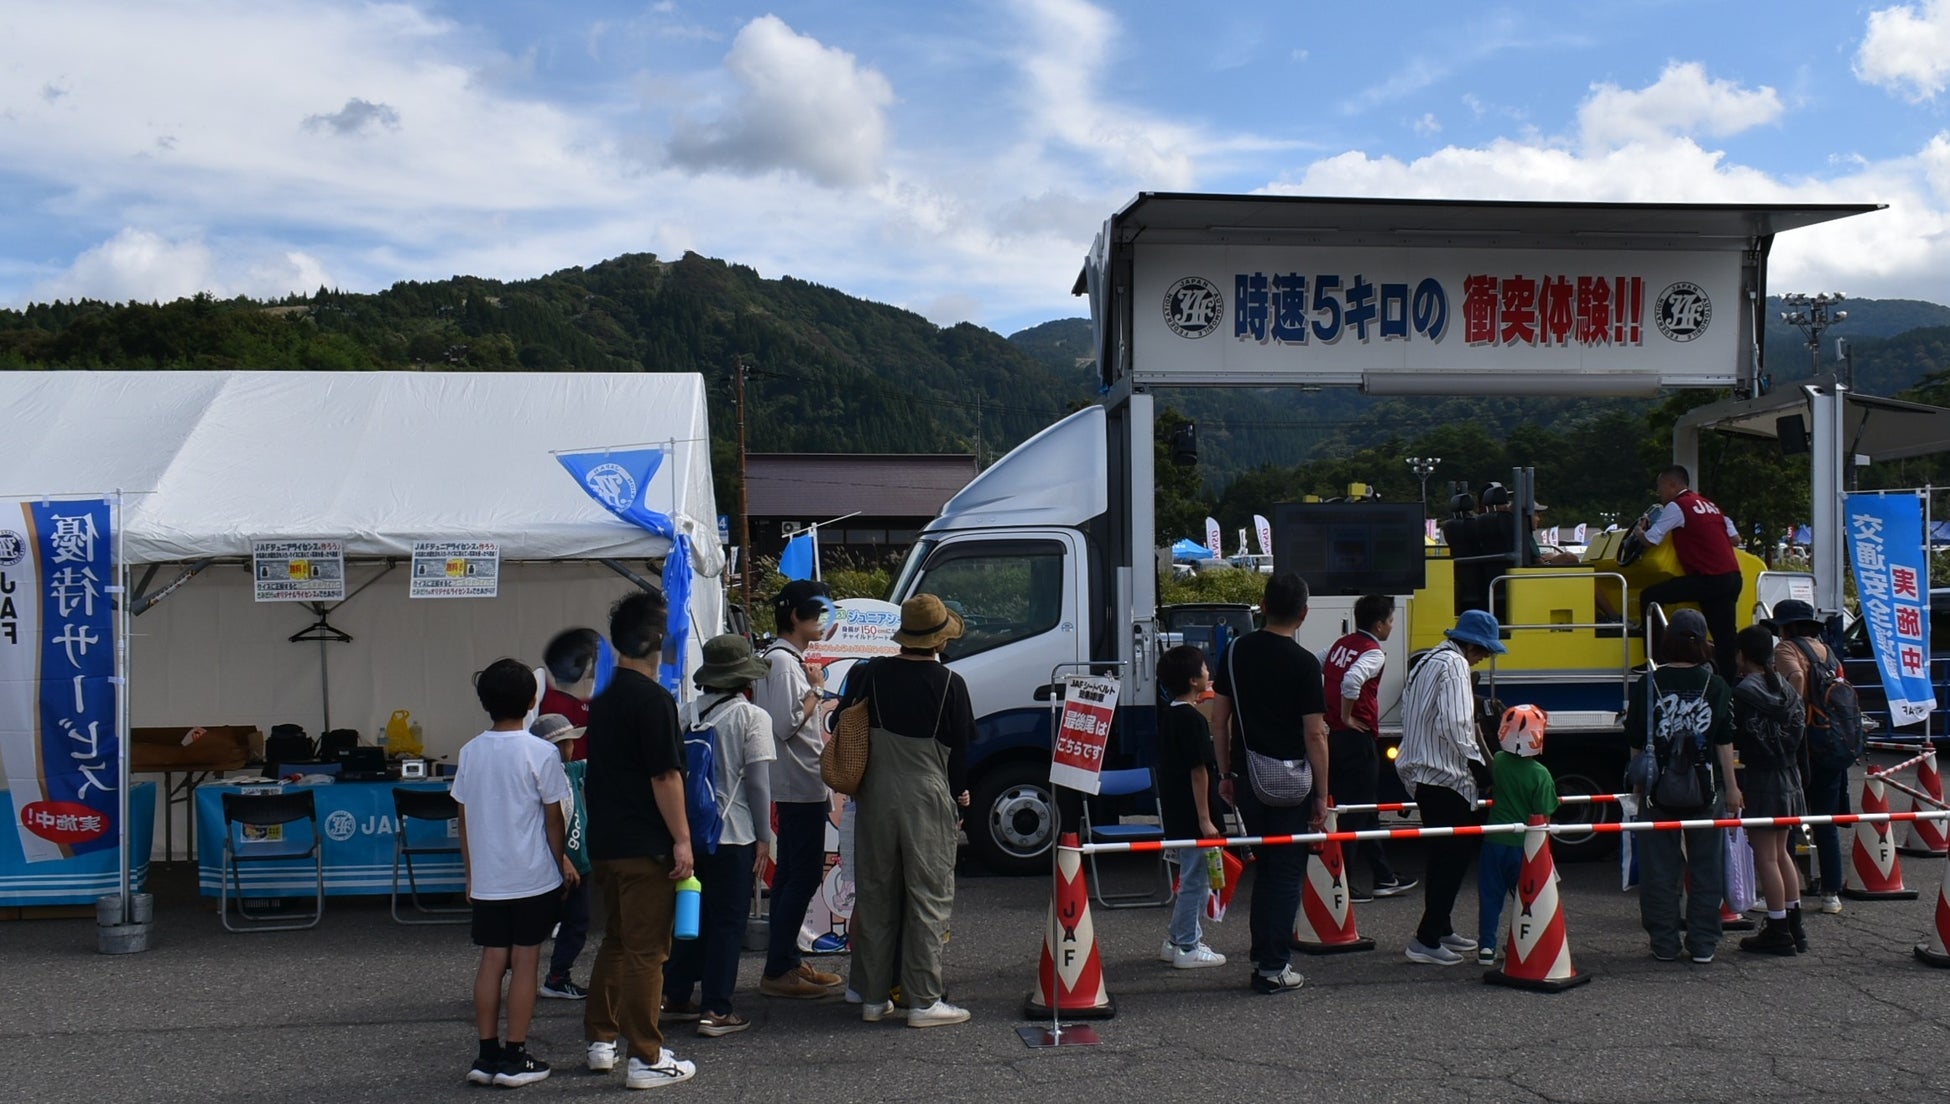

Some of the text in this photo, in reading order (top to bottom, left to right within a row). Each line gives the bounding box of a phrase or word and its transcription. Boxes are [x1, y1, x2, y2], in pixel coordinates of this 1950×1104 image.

[1164, 279, 1222, 337] JAPAN AUTOMOBILE FEDERATION
[1234, 272, 1645, 346] 時速5キロの 衝突体験!!
[1656, 283, 1710, 340] JAPAN AUTOMOBILE FEDERATION
[718, 517, 727, 529] 4
[1330, 645, 1359, 668] JAF
[1056, 738, 1103, 760] こちらです
[1063, 710, 1108, 737] 最後尾は
[1331, 853, 1344, 910] JAF
[1519, 879, 1535, 940] JAF
[1062, 901, 1077, 967] JAF
